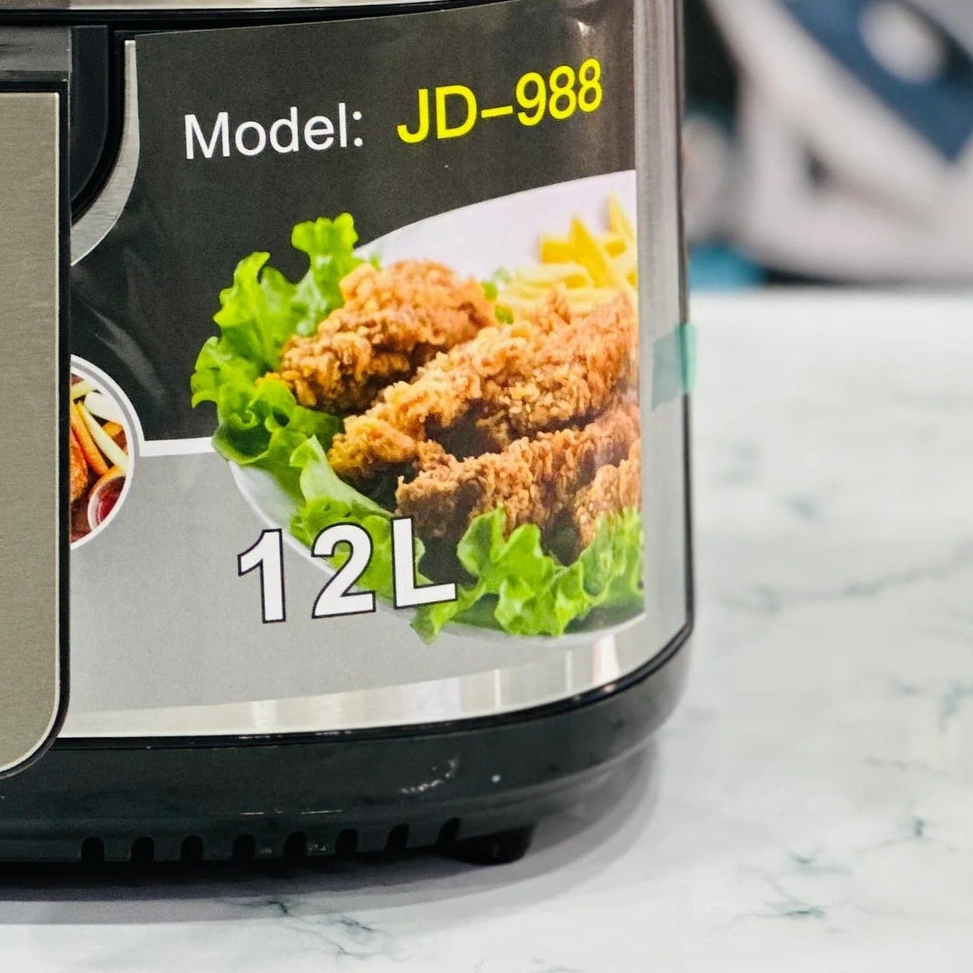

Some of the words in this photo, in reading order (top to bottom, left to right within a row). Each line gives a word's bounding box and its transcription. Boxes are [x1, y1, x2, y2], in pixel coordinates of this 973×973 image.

[184, 102, 364, 160] Model:
[396, 58, 604, 144] JD-988
[237, 515, 459, 624] 12L
